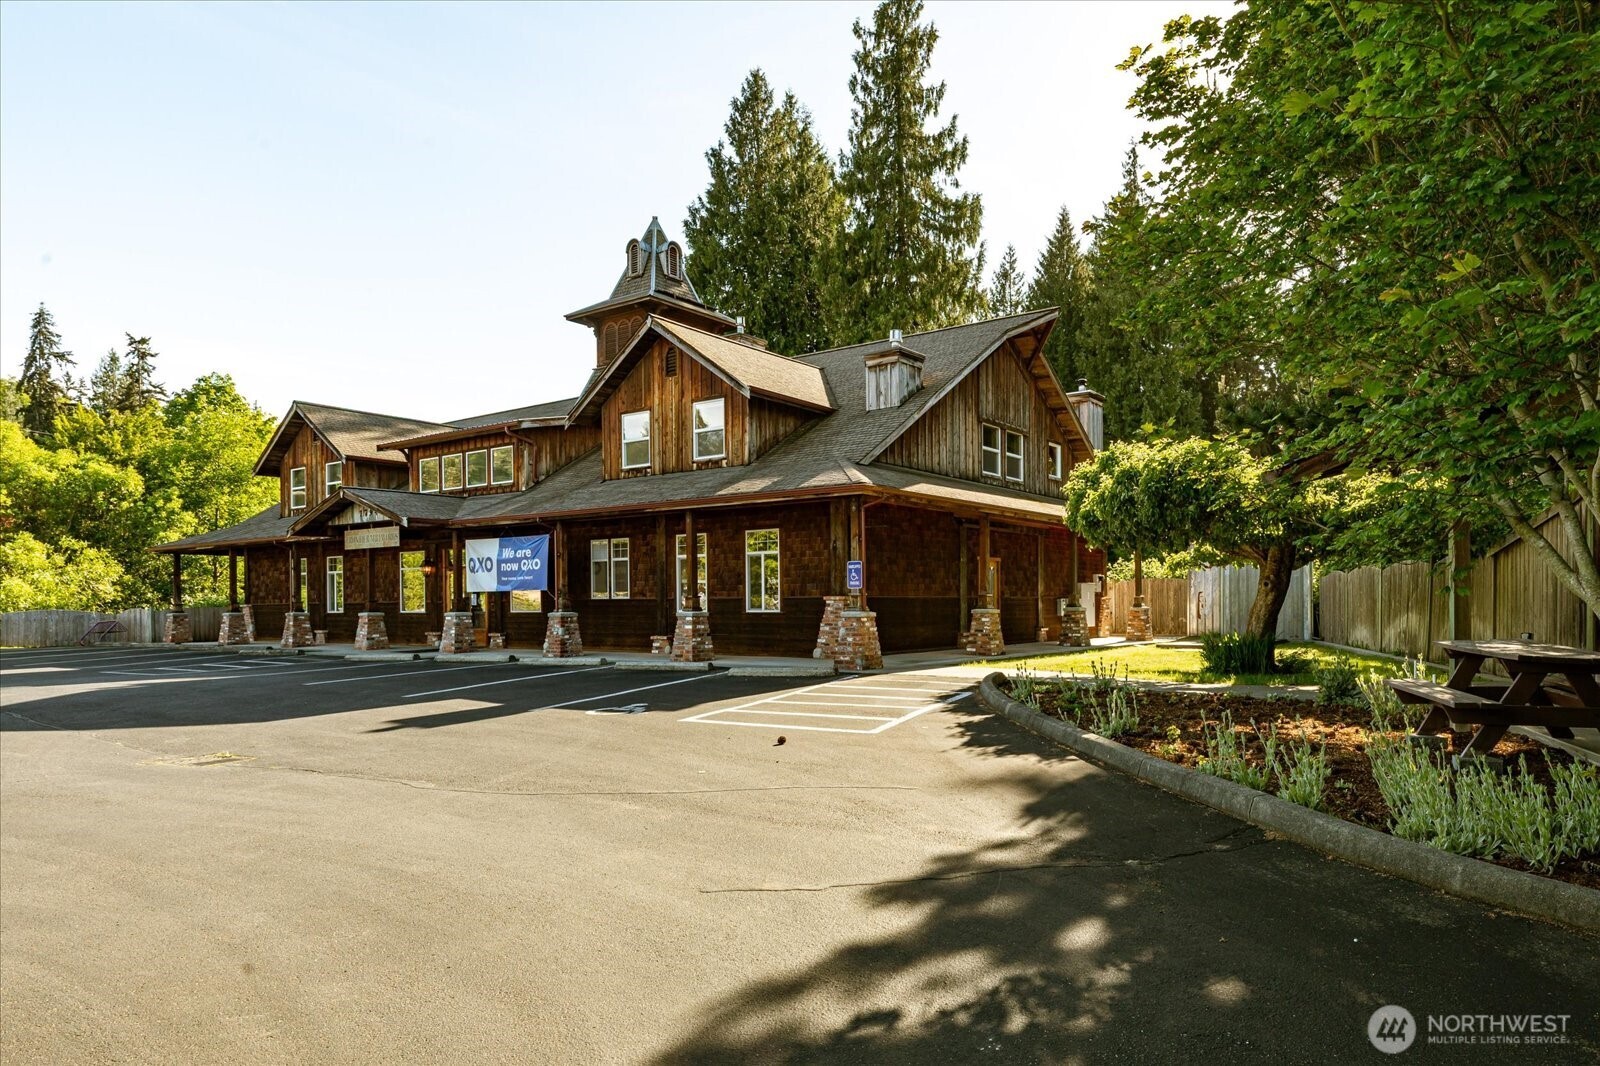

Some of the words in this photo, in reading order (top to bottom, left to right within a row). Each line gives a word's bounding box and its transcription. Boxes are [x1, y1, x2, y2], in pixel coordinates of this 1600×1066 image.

[502, 547, 515, 559] We
[516, 548, 532, 558] are
[468, 556, 494, 575] QXO
[501, 562, 519, 572] now
[520, 558, 541, 572] QXO
